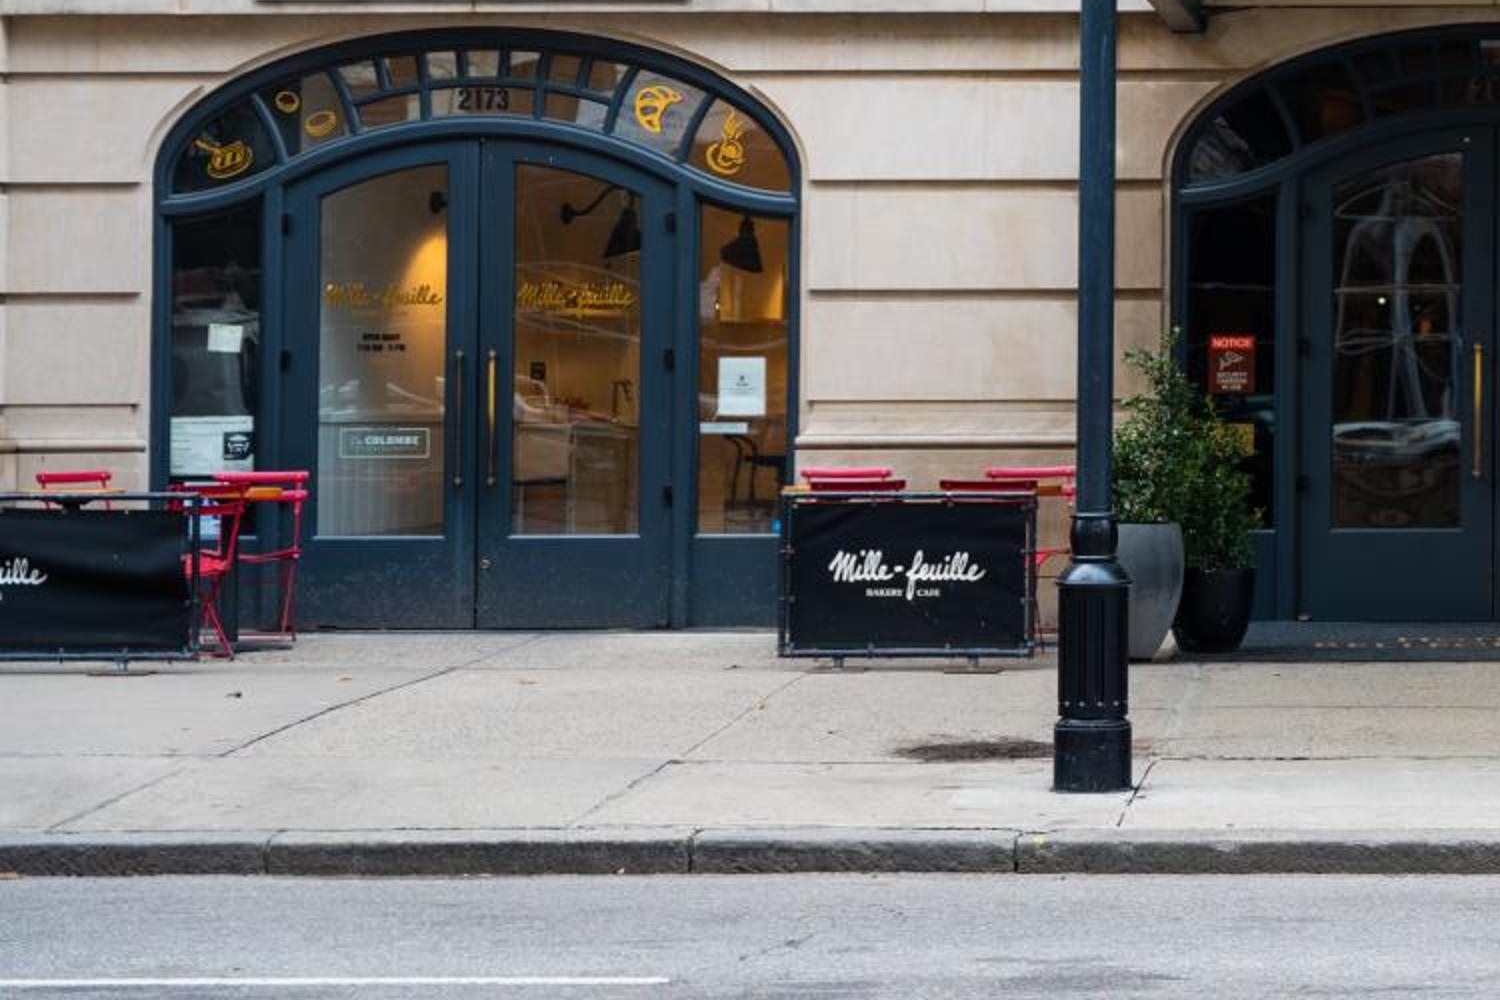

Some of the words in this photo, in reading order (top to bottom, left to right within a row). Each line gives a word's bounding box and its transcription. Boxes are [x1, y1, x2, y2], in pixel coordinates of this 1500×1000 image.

[458, 88, 509, 111] 2173
[1211, 337, 1253, 348] NOTICE
[865, 588, 904, 597] BAKERY
[916, 588, 941, 597] CAFE
